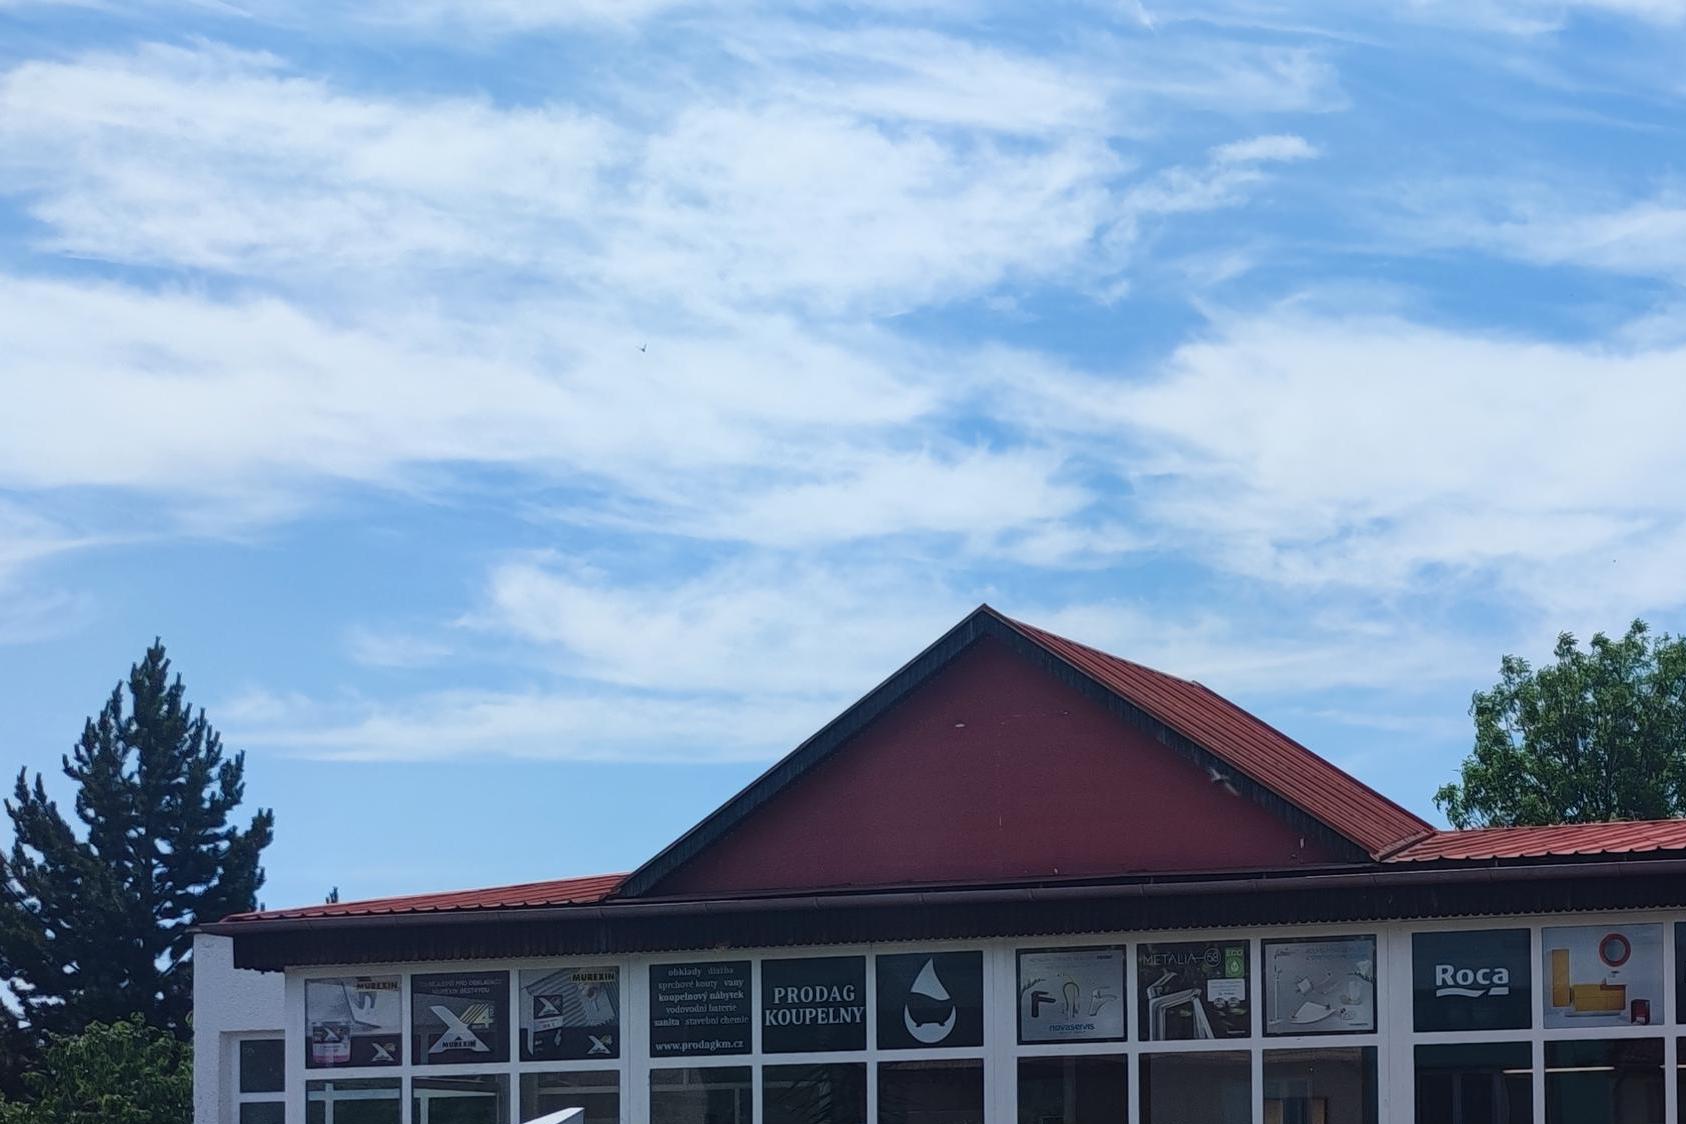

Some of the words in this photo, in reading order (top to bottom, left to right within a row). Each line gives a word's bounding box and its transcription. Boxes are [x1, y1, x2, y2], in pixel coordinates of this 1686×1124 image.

[1143, 953, 1197, 966] METALIA
[571, 972, 615, 982] MUREXIN
[668, 967, 702, 977] obklady
[1435, 964, 1509, 986] Roca
[658, 991, 708, 1003] koupelnový
[709, 990, 744, 1001] nábytek
[773, 984, 855, 1004] PRODAG
[765, 1006, 865, 1026] KOUPELNY
[656, 1040, 744, 1052] www.prodagkm.cz
